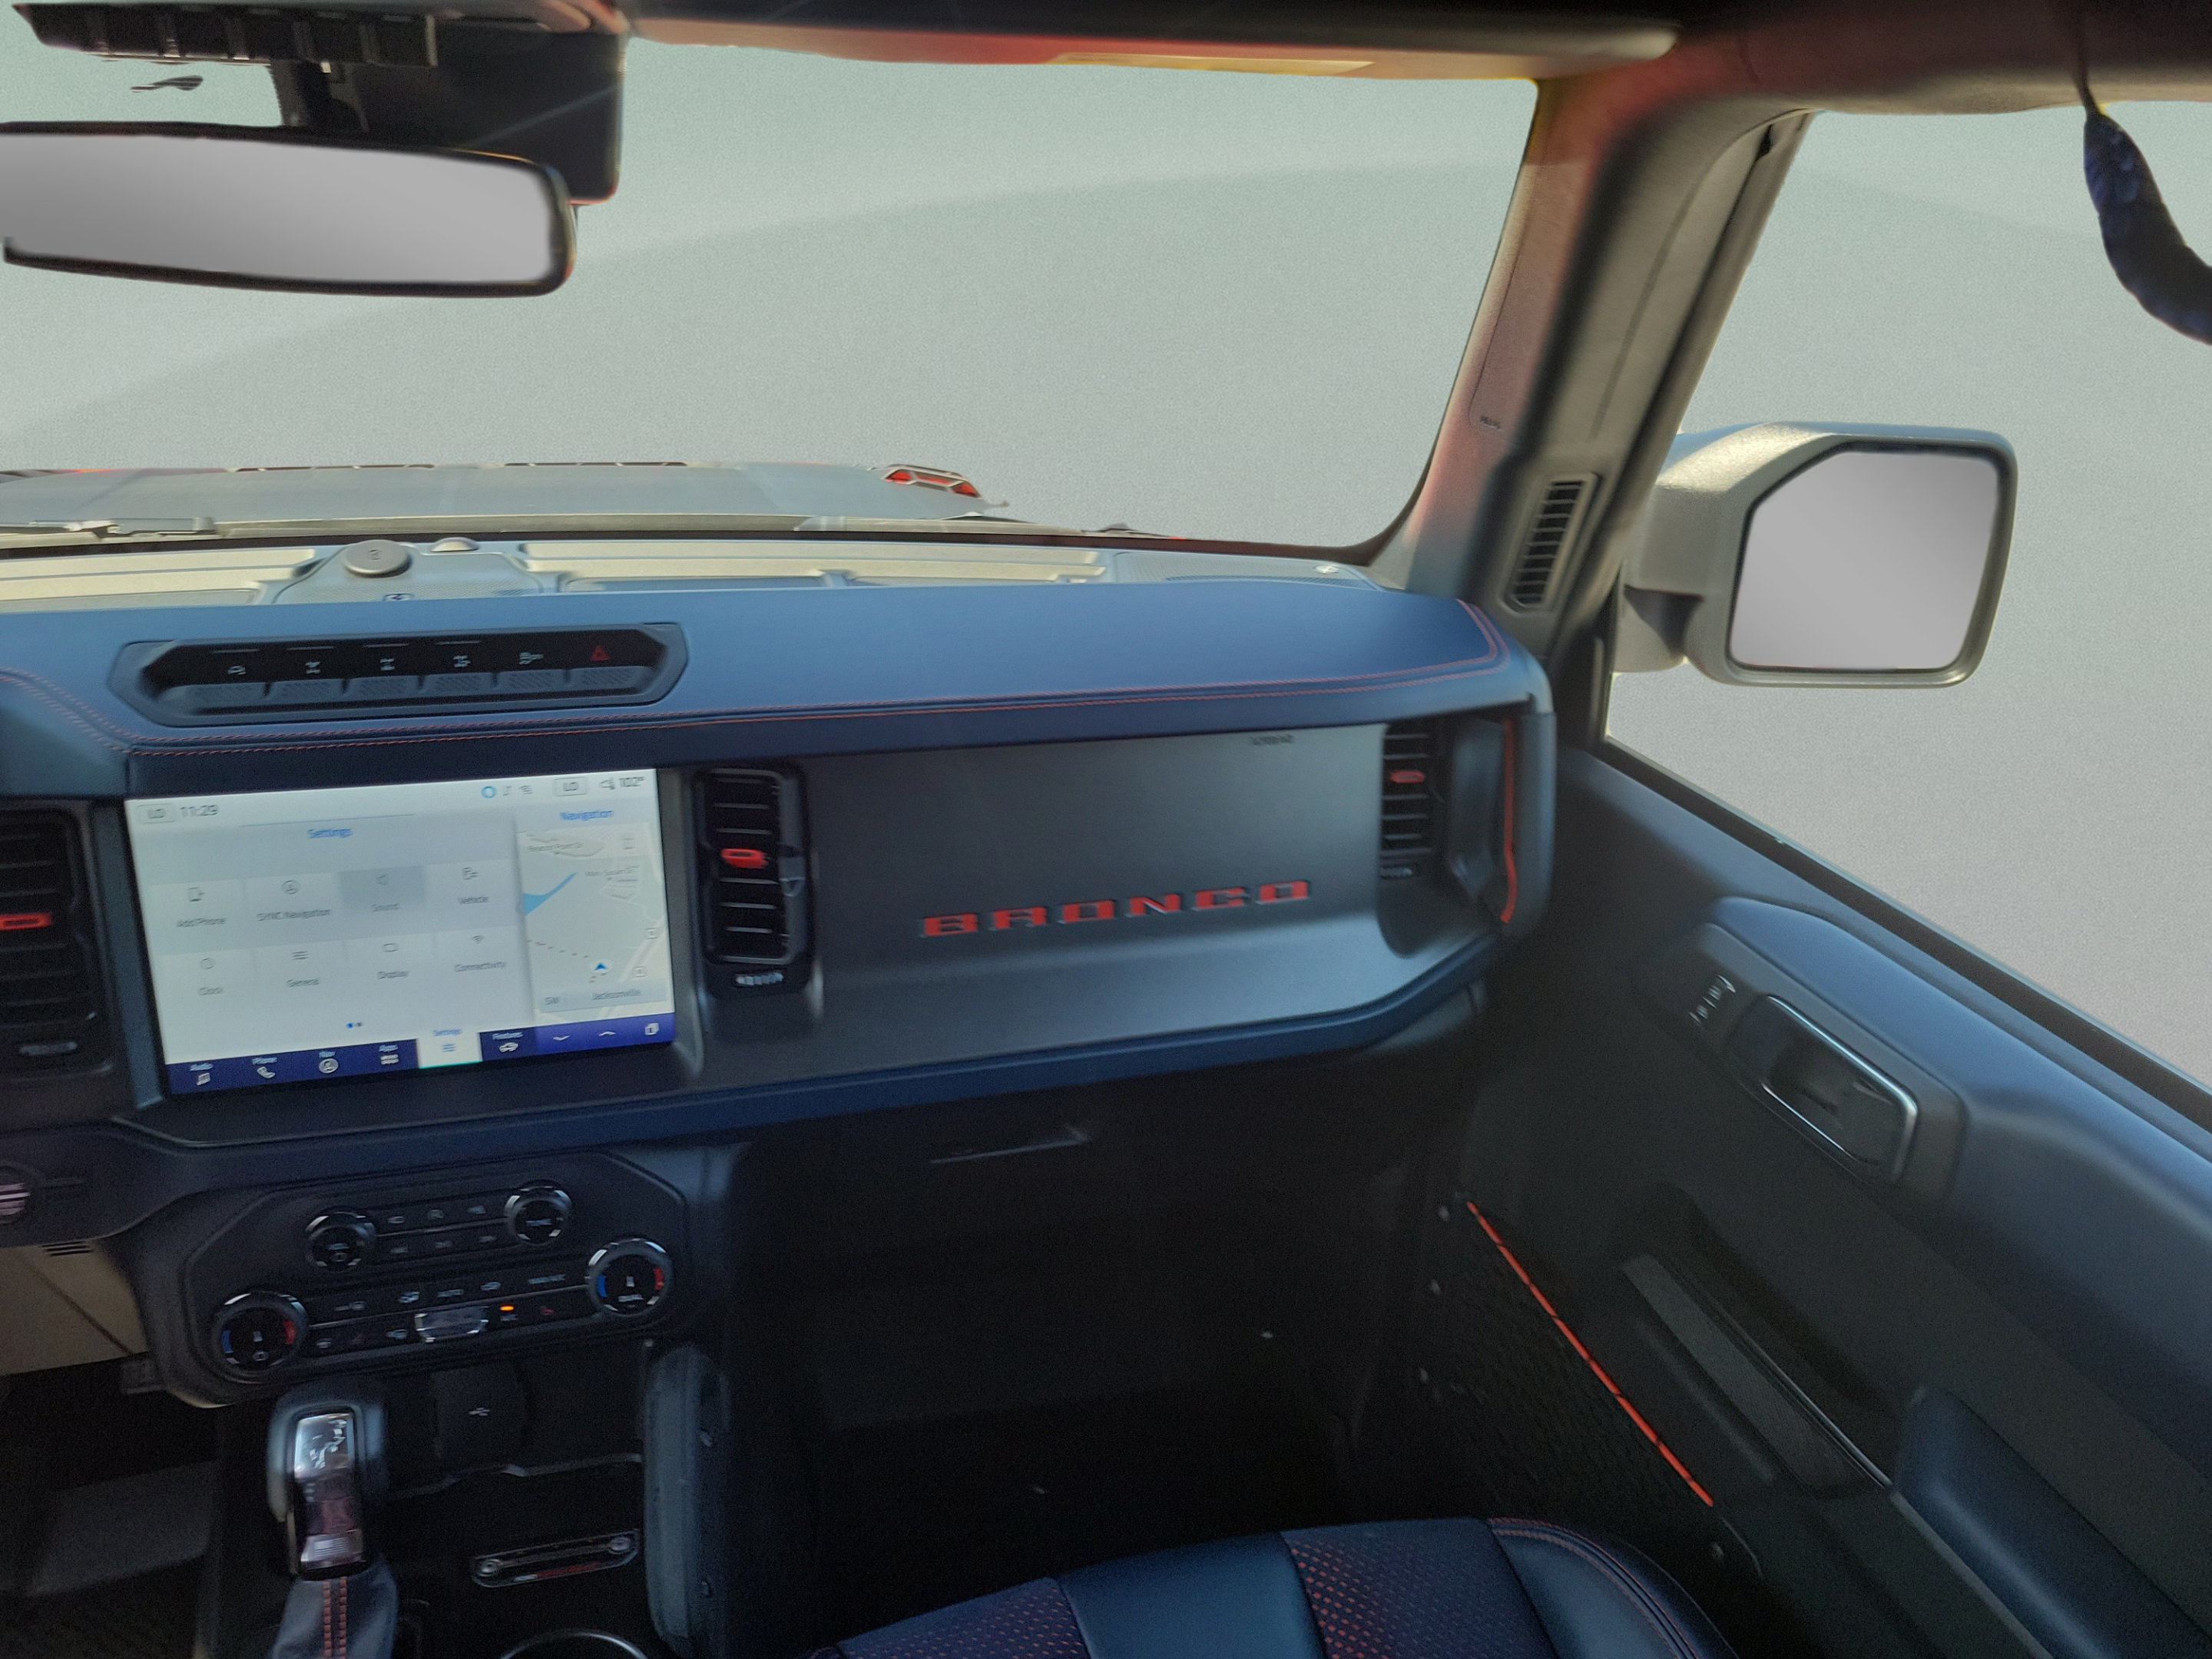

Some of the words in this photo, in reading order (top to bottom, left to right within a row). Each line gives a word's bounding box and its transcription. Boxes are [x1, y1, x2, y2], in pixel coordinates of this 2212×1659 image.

[559, 810, 614, 822] Navigation
[307, 827, 354, 839] Settings
[920, 879, 1309, 937] BRONCO
[455, 960, 507, 973] Connectivity
